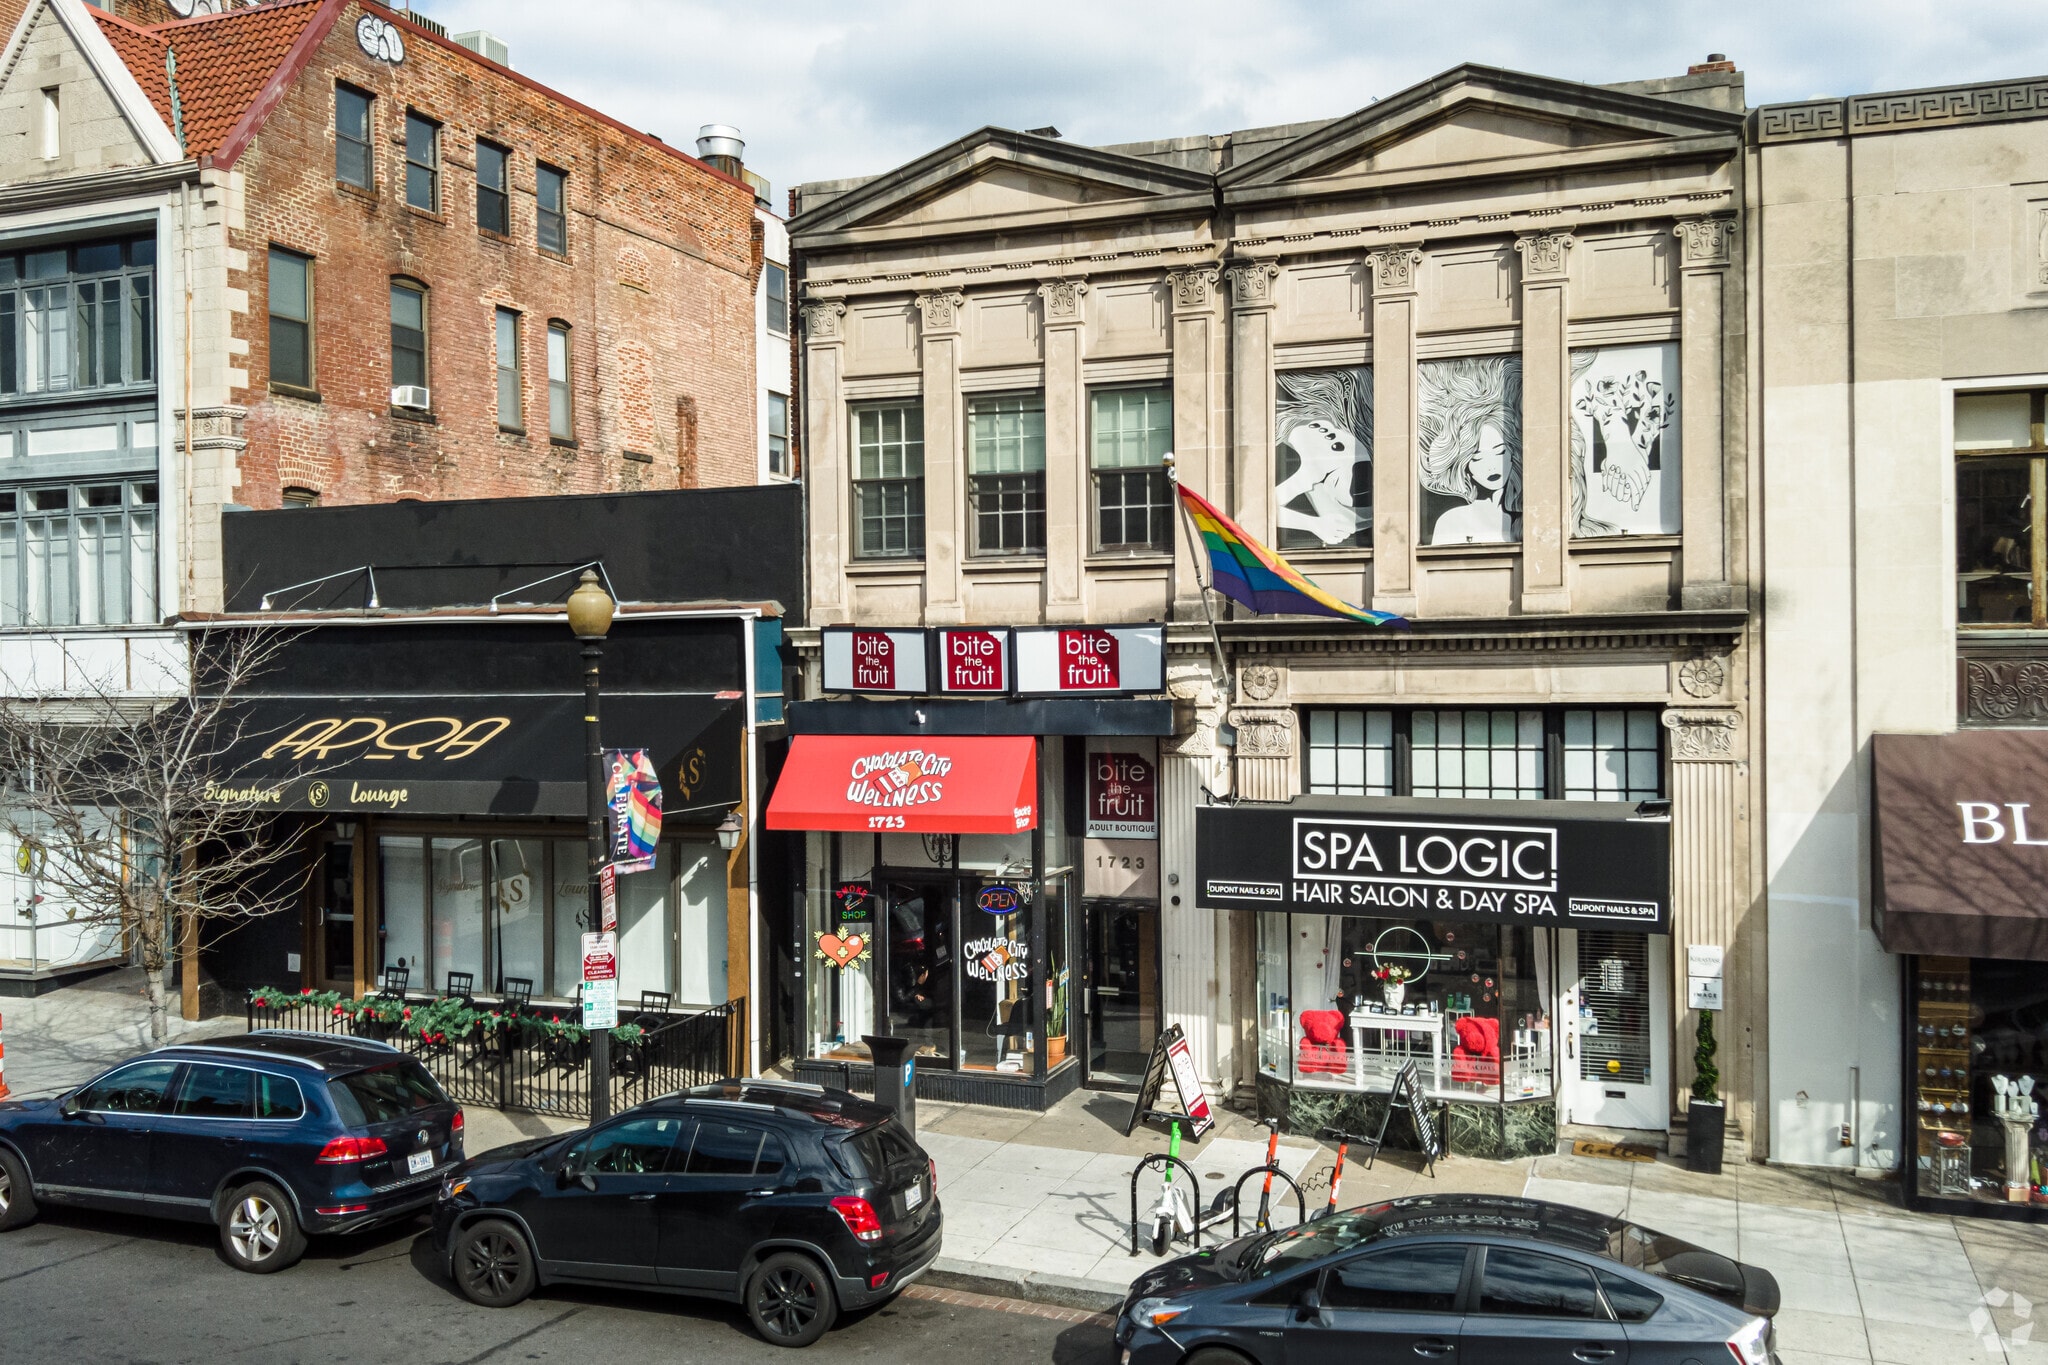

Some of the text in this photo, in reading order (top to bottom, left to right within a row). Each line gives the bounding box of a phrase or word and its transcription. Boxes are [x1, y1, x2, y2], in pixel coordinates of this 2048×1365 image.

[858, 636, 889, 656] bite
[953, 636, 994, 656] bite
[1066, 634, 1111, 655] bite
[865, 656, 880, 666] the
[964, 656, 982, 667] the
[1078, 654, 1098, 665] the
[858, 664, 889, 684] fruit
[955, 665, 994, 685] fruit
[1067, 664, 1111, 685] fruit
[921, 753, 952, 777] CITY
[1097, 759, 1145, 782] bite
[203, 779, 281, 807] Signature
[350, 781, 409, 809] Lounge
[1110, 783, 1131, 794] the
[612, 762, 629, 855] CELEBRATE
[1098, 793, 1145, 816] fruit
[868, 816, 905, 829] 1723
[1089, 824, 1156, 833] ADULT BOUTIQUE
[1302, 831, 1383, 872] SPA
[1096, 856, 1145, 869] 1723
[835, 885, 868, 899] SMOKE
[1210, 885, 1280, 896] DUPONT NAILS & SPA
[1292, 882, 1558, 917] HAIR SALON & DAY SPA
[980, 893, 1018, 908] OPEN
[1572, 903, 1655, 916] DUPONT NAILS & SPA
[841, 910, 867, 920] SHOP
[1007, 940, 1028, 959] CITY
[904, 1063, 911, 1082] P
